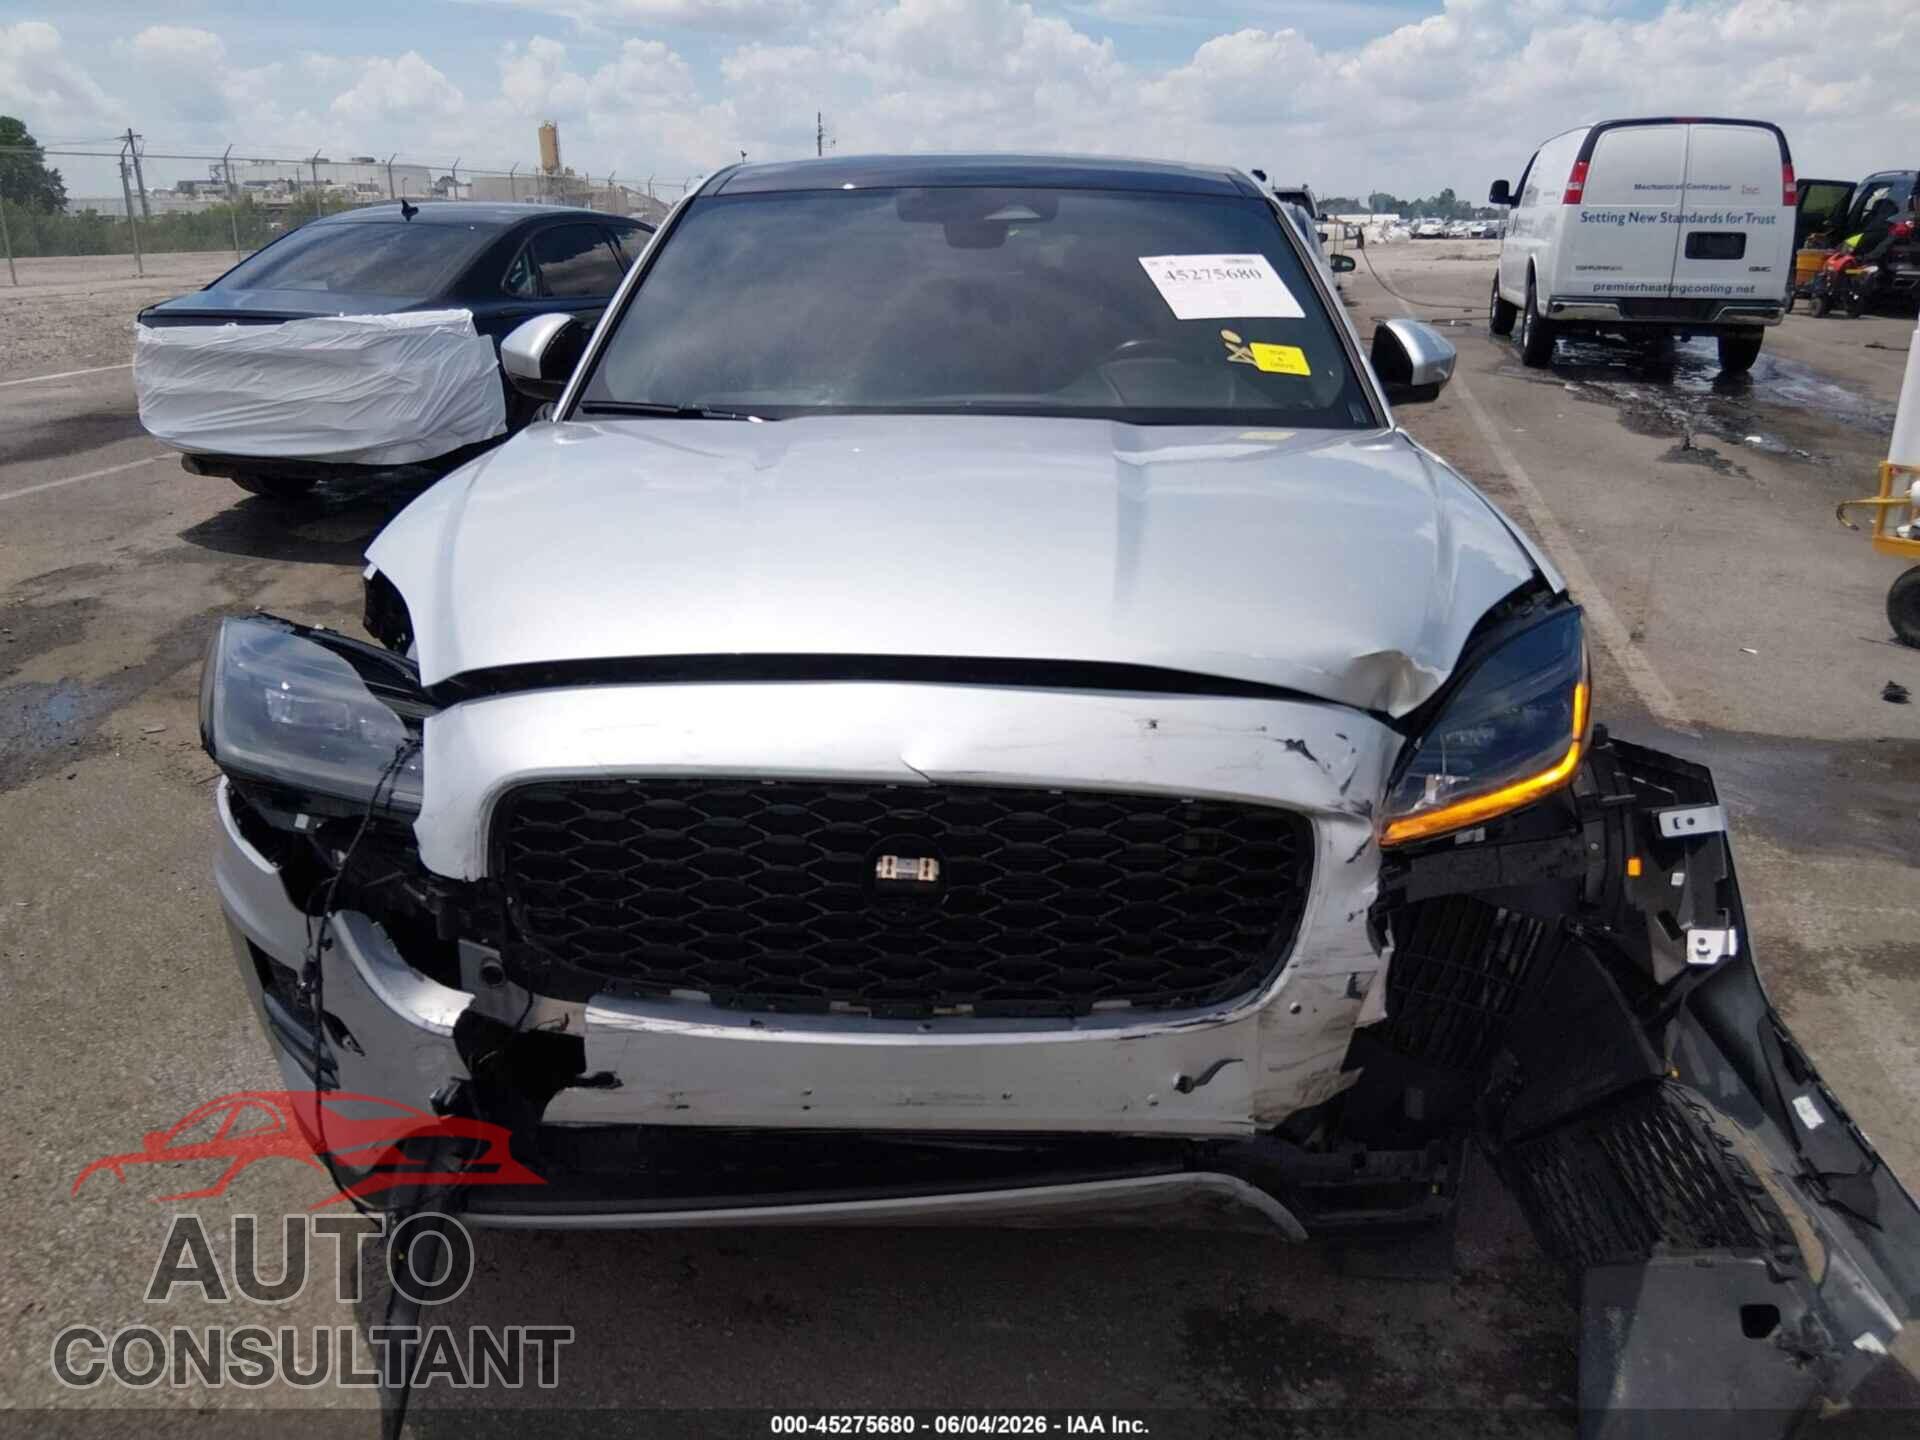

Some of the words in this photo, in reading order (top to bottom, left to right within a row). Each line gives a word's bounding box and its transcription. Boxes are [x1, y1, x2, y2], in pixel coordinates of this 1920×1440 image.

[1685, 183, 1731, 191] Contractor
[1580, 211, 1626, 226] Setting
[1628, 211, 1657, 224] New
[1659, 211, 1723, 224] Standards
[1725, 212, 1743, 224] for
[1745, 212, 1777, 225] Trust
[1164, 266, 1263, 282] 45275680
